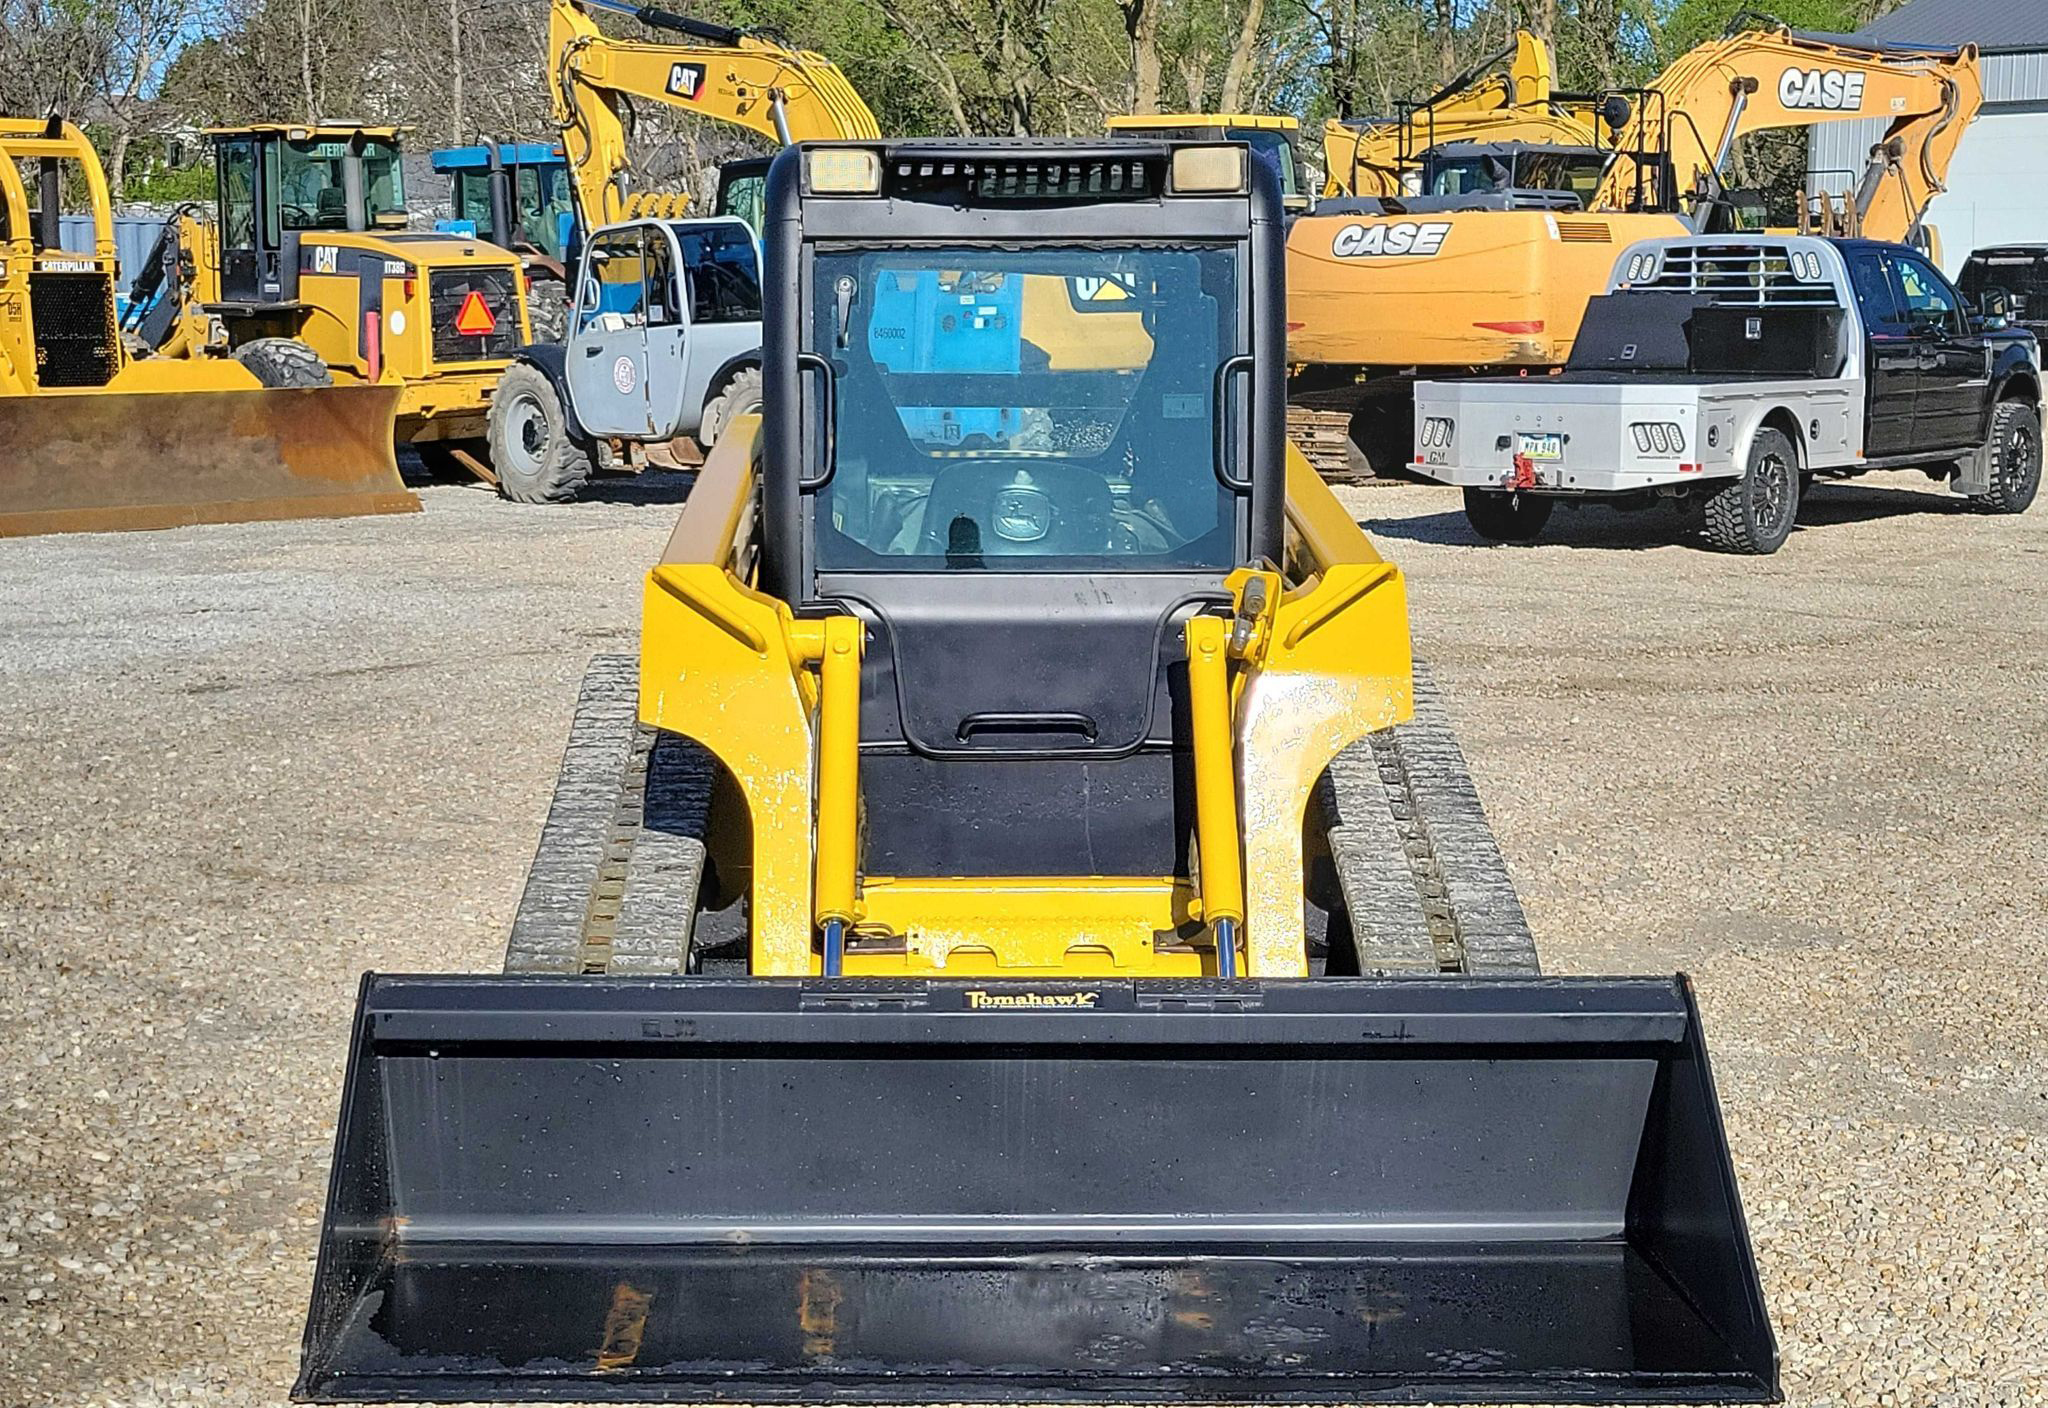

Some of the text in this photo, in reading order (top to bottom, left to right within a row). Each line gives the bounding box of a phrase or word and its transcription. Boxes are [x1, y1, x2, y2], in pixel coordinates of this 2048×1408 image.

[671, 66, 699, 95] CAT
[1777, 67, 1866, 111] CASE
[1332, 222, 1453, 257] CASE
[41, 261, 96, 272] CATERPILLAR
[315, 246, 339, 274] CAT
